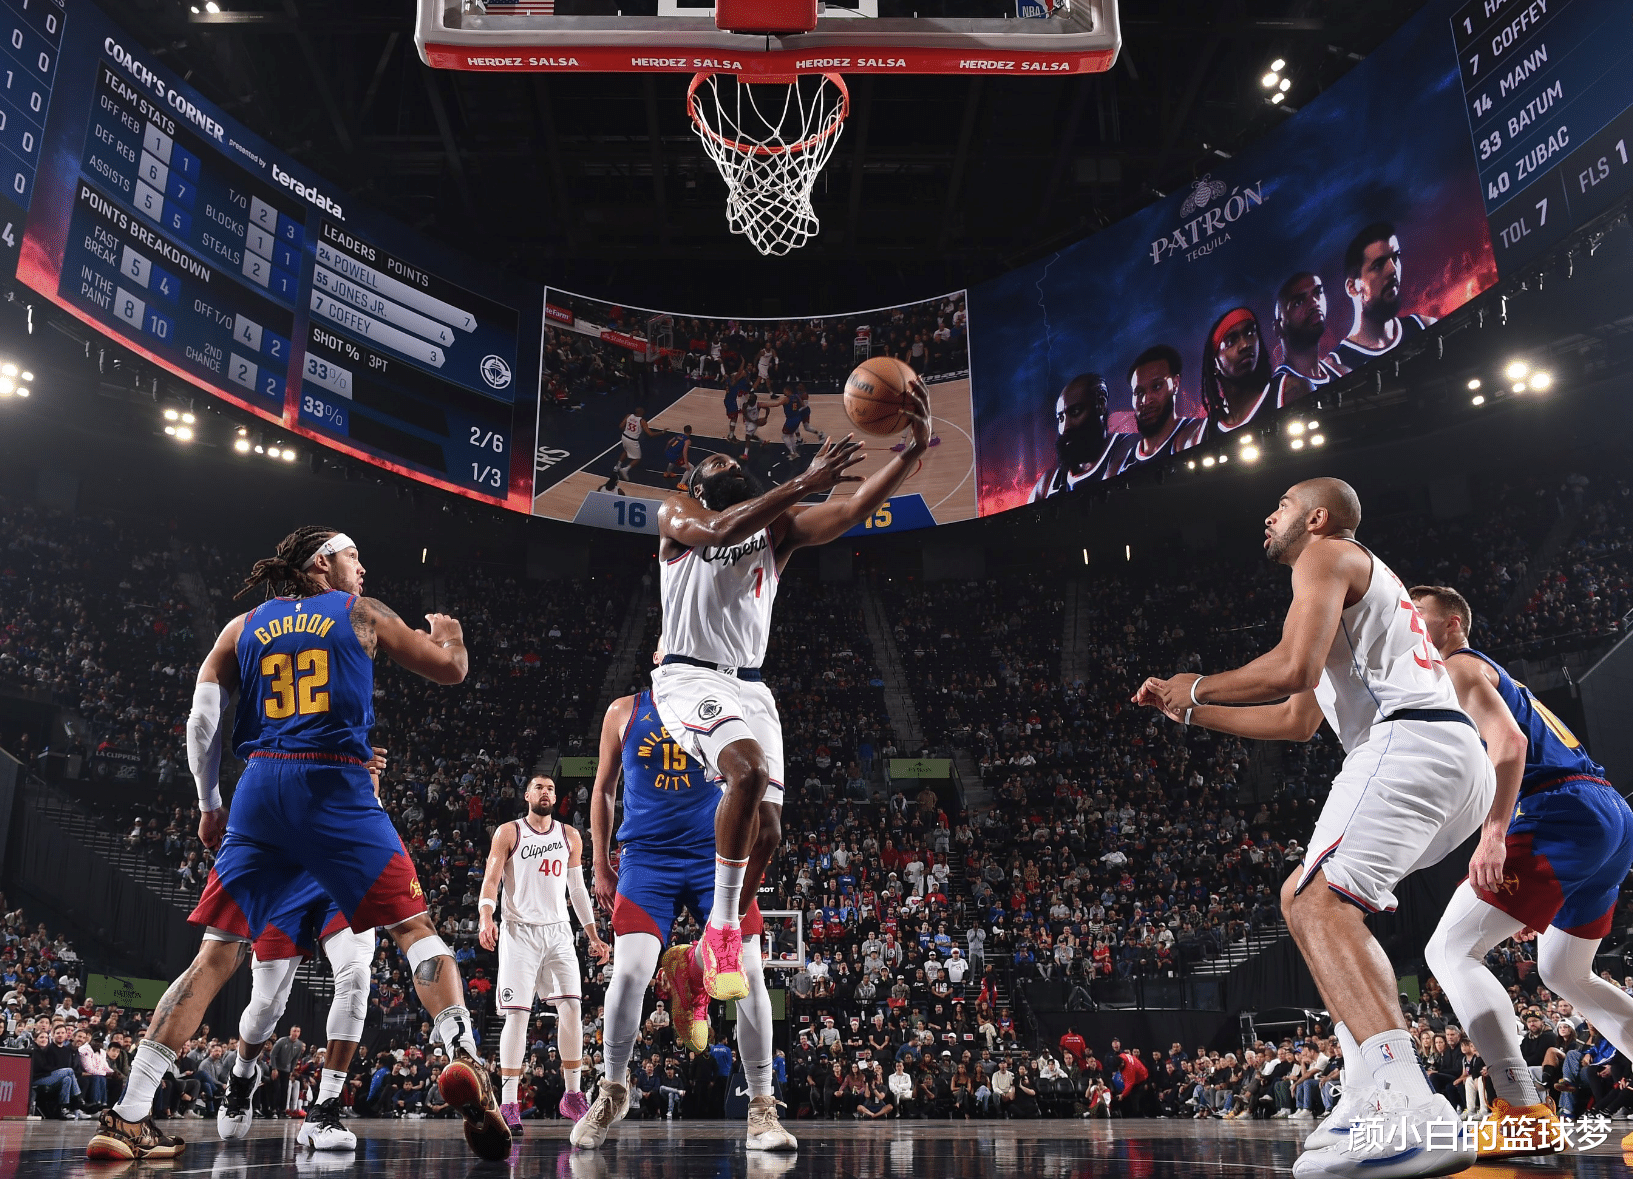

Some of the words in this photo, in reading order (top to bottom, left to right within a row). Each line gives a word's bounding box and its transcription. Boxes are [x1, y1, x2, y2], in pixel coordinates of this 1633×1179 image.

[46, 14, 57, 34] 0
[1022, 5, 1041, 18] NBA
[1463, 17, 1473, 35] 1
[12, 29, 23, 49] 0
[38, 52, 50, 72] 0
[1469, 54, 1479, 76] 7
[1491, 0, 1547, 56] COFFEY
[467, 57, 523, 67] HERDEZ
[529, 57, 579, 67] SALSA
[631, 57, 687, 68] HERDEZ
[693, 58, 743, 70] SALSA
[795, 58, 851, 69] HERDEZ
[857, 58, 906, 68] SALSA
[959, 60, 1015, 70] HERDEZ
[1020, 61, 1070, 71] SALSA
[1473, 93, 1493, 118] 14
[1499, 43, 1548, 97] MANN
[6, 71, 13, 88] 1
[30, 91, 41, 112] 0
[104, 69, 137, 106] TEAM
[139, 99, 175, 135] STATS
[100, 95, 119, 117] OFF
[121, 110, 140, 134] REB
[155, 138, 161, 150] 1
[183, 157, 189, 171] 1
[104, 37, 165, 98] COACH'S
[167, 89, 225, 143] CORNER
[229, 138, 259, 163] presented
[259, 157, 267, 169] by
[272, 163, 346, 221] teradata.
[1479, 130, 1502, 160] 33
[1507, 79, 1563, 139] BATUM
[22, 132, 34, 152] 0
[95, 124, 114, 146] DEF
[115, 139, 136, 163] REB
[149, 165, 157, 179] 6
[178, 184, 186, 198] 7
[1488, 171, 1510, 200] 40
[1515, 125, 1570, 181] ZUBAC
[14, 173, 26, 194] 0
[1578, 156, 1610, 193] FLS
[1615, 139, 1629, 165] 1
[89, 154, 130, 191] ASSISTS
[144, 195, 152, 209] 5
[173, 214, 181, 229] 5
[2, 223, 15, 247] 4
[81, 187, 127, 228] POINTS
[130, 224, 210, 283] BREAKDOWN
[205, 204, 244, 237] BLOCKS
[257, 236, 263, 250] 1
[285, 252, 291, 265] 1
[229, 189, 247, 209] T/O
[260, 208, 268, 222] 2
[287, 225, 295, 239] 3
[1149, 180, 1262, 265] PATRÓN
[1500, 217, 1531, 249] TOL
[1535, 198, 1548, 227] 7
[94, 225, 119, 250] FAST
[324, 224, 376, 261] LEADERS
[387, 257, 430, 287] POINTS
[1186, 233, 1231, 262] TEQUILA
[81, 265, 93, 281] IN
[94, 270, 113, 295] THE
[84, 236, 117, 267] BREAK
[131, 258, 140, 276] 5
[159, 277, 170, 295] 4
[202, 233, 240, 265] STEALS
[252, 263, 261, 277] 2
[281, 279, 287, 292] 1
[316, 271, 329, 286] 55
[331, 281, 368, 309] JONES
[370, 299, 387, 317] JR.
[439, 331, 446, 341] 4
[319, 247, 331, 263] 24
[334, 254, 378, 289] POWELL
[464, 317, 471, 328] 7
[81, 284, 111, 310] PAINT
[124, 300, 135, 318] 8
[151, 315, 167, 338] 10
[194, 299, 213, 320] OFF
[215, 309, 233, 330] T/O
[243, 320, 252, 339] 4
[271, 340, 281, 357] 2
[316, 297, 324, 310] 7
[329, 304, 371, 334] COFFEY
[430, 351, 437, 362] 3
[185, 345, 221, 373] CHANCE
[238, 364, 248, 380] 2
[266, 379, 276, 395] 2
[204, 343, 222, 360] 2ND
[313, 329, 343, 353] SHOT
[345, 343, 360, 361] %
[369, 355, 389, 372] 3PT
[307, 358, 347, 389] 33%
[303, 396, 343, 426] 33%
[469, 427, 503, 453] 2/6
[471, 462, 501, 487] 1/3
[614, 500, 647, 528] 16
[865, 503, 892, 529] 15
[254, 613, 335, 645] GORDON
[260, 648, 330, 719] 32
[637, 726, 671, 757] MILE
[662, 743, 687, 771] 15
[654, 773, 691, 791] CITY
[521, 840, 564, 861] Clippers
[538, 858, 562, 877] 40
